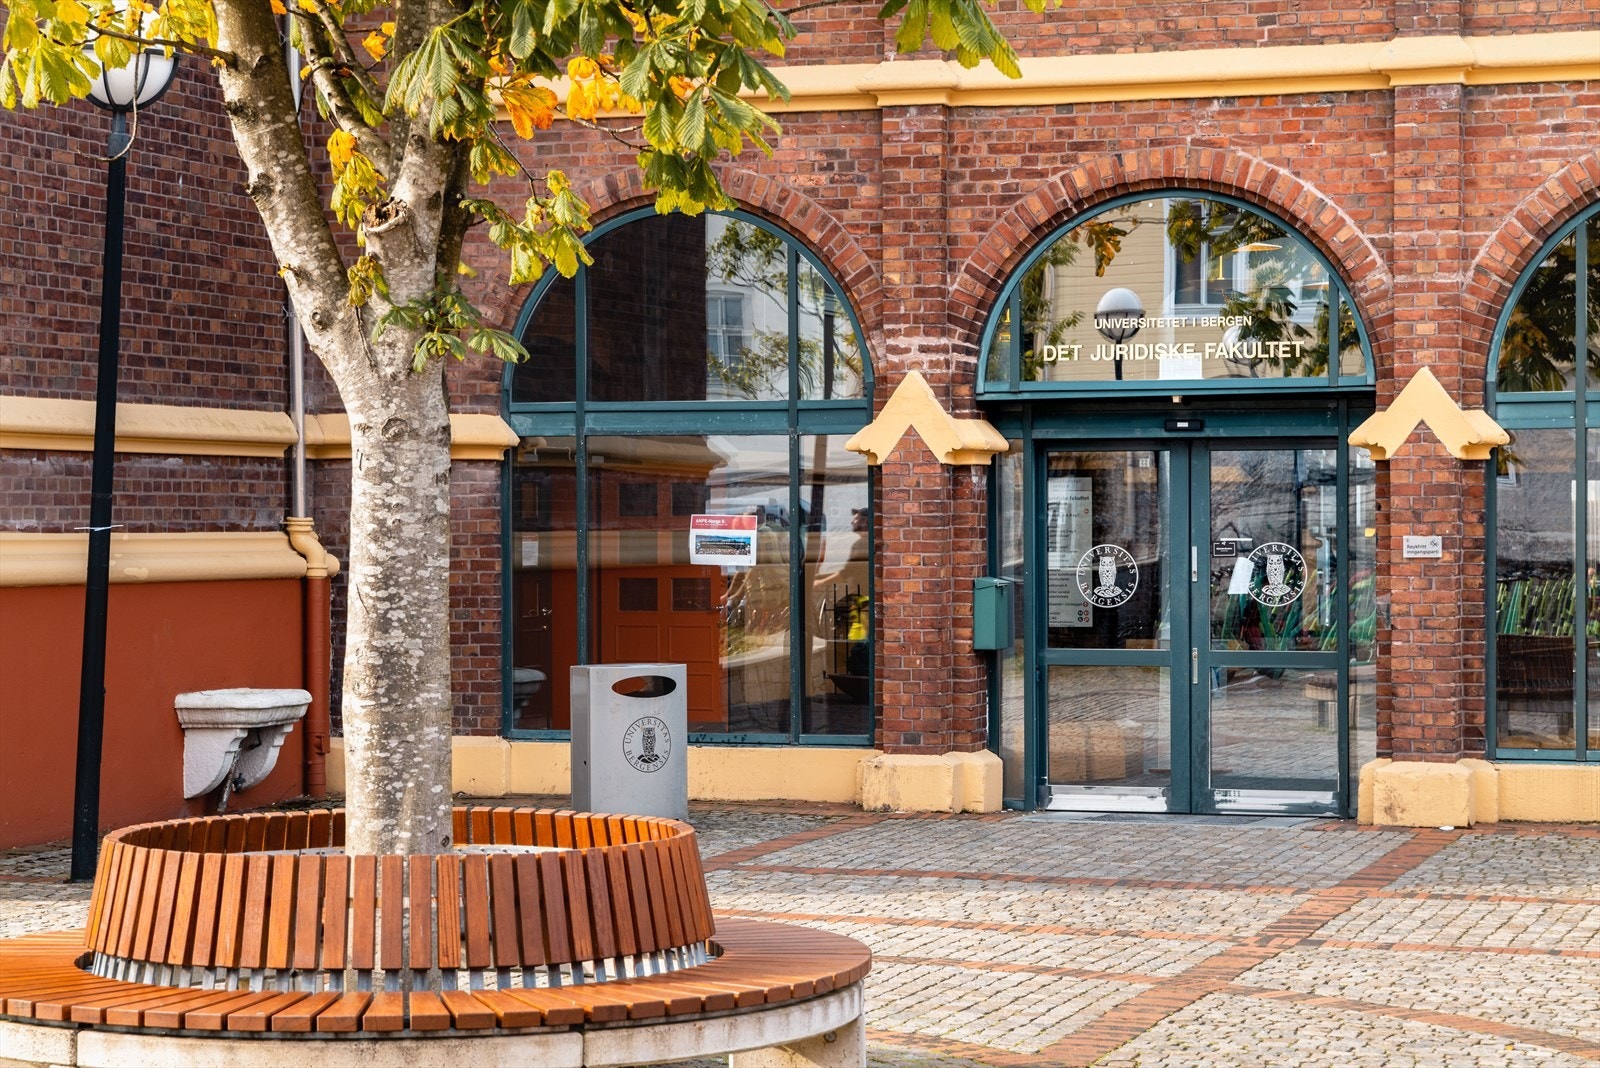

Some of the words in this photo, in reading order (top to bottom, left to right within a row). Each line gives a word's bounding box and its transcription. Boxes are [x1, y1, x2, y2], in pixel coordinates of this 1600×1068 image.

[1094, 317, 1188, 329] UNIVERSITETET
[1192, 317, 1196, 327] I
[1201, 316, 1252, 327] BERGEN
[1043, 344, 1082, 362] DET
[1091, 342, 1196, 361] JURIDISKE
[1204, 341, 1304, 359] FAKULTET
[1079, 547, 1136, 576] UNIVERSITAS
[1251, 545, 1305, 572] IVERSITAS
[1081, 582, 1135, 606] BERGENSIS
[625, 719, 669, 744] UNIVERSITAS
[626, 750, 669, 771] BERGENSIS
